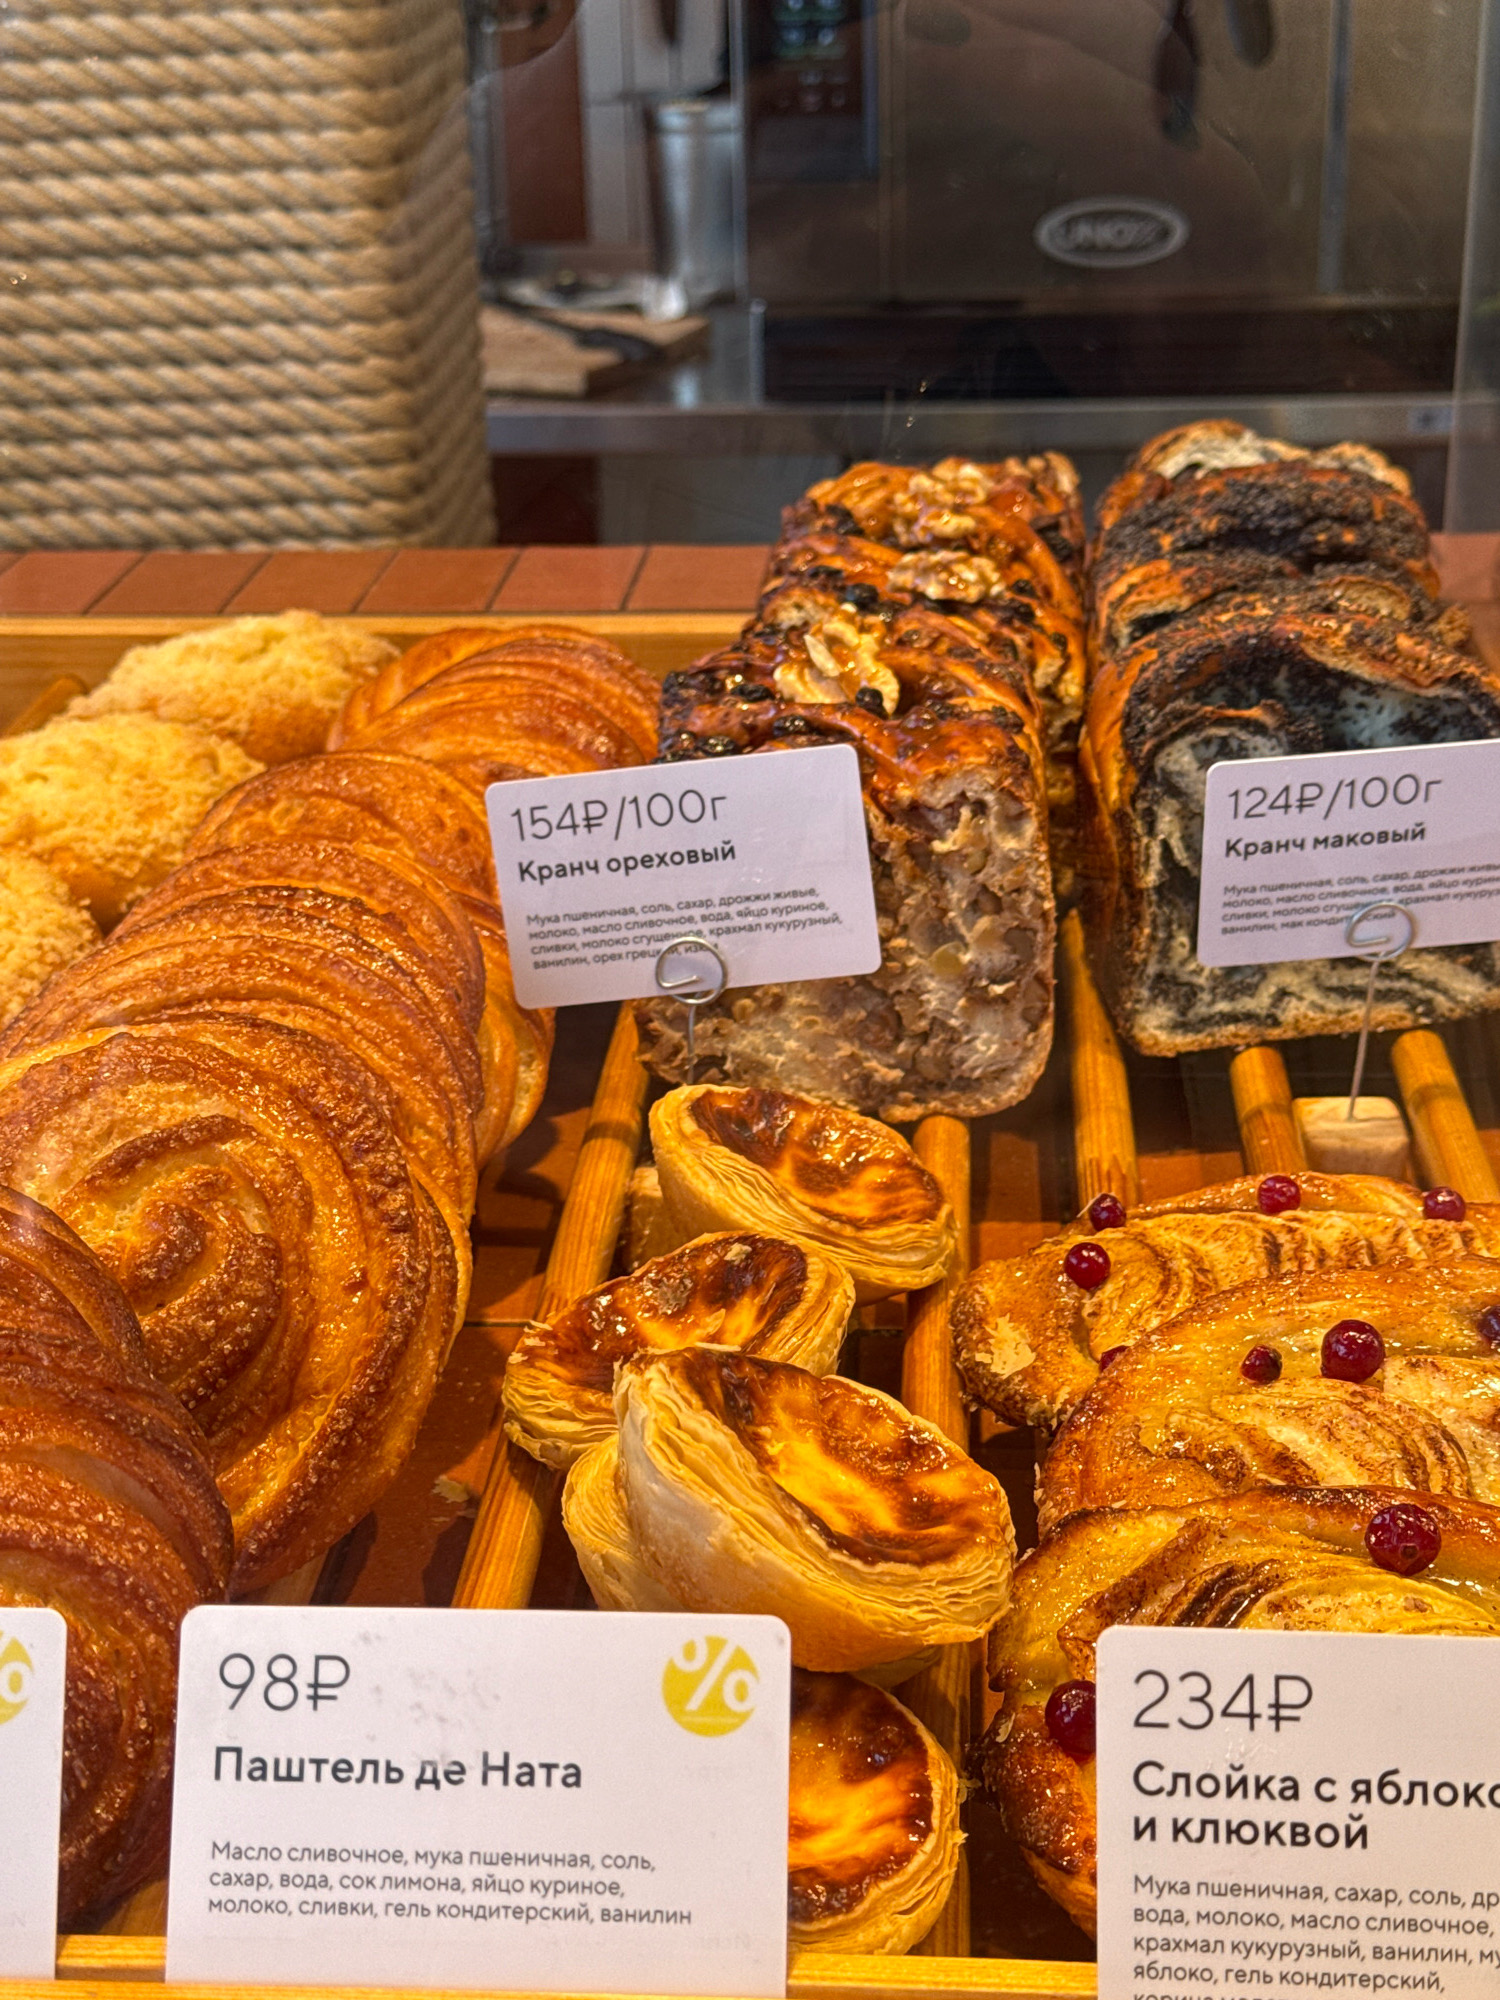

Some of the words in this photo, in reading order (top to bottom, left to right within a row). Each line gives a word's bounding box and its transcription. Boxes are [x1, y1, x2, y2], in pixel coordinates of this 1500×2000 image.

[511, 789, 727, 842] 154₽/100г
[1228, 773, 1442, 820] 124₽/100г
[1225, 837, 1305, 861] Кранч
[1312, 822, 1427, 850] маковый
[518, 860, 599, 885] Кранч
[607, 840, 736, 877] ореховый
[526, 914, 560, 928] Мука
[562, 906, 638, 922] пшеничная,
[641, 903, 674, 914] соль,
[676, 898, 716, 911] сахар,
[718, 893, 771, 907] дрожжи
[772, 887, 820, 900] живые,
[1224, 885, 1257, 897] Мука
[528, 928, 580, 940] молоко,
[582, 923, 622, 934] масло
[624, 915, 698, 930] сливочное,
[701, 911, 733, 923] вода,
[736, 905, 768, 918] яйцо
[771, 901, 830, 916] куриное,
[531, 944, 579, 955] сливки,
[581, 937, 630, 949] молоко
[709, 923, 762, 937] крахмал
[765, 913, 843, 933] кукурузный,
[1281, 919, 1303, 929] мак
[533, 957, 590, 970] ванилин,
[593, 951, 624, 965] орех
[218, 1652, 350, 1712] 98₽
[1133, 1669, 1313, 1732] 234₽
[213, 1746, 404, 1785] Паштель
[415, 1756, 466, 1790] де
[480, 1752, 583, 1789] Ната
[1133, 1760, 1300, 1801] Слойка
[1314, 1777, 1338, 1802] с
[1133, 1816, 1157, 1842] и
[1173, 1813, 1368, 1850] клюквой
[211, 1841, 282, 1863] Масло
[287, 1847, 408, 1867] сливочное,
[414, 1849, 464, 1871] мука
[469, 1848, 594, 1871] пшеничная,
[601, 1853, 655, 1873] соль,
[209, 1872, 274, 1893] сахар,
[279, 1873, 333, 1893] вода,
[339, 1874, 377, 1890] сок
[380, 1875, 466, 1895] лимона,
[471, 1871, 525, 1896] яйцо
[529, 1878, 626, 1901] куриное,
[1134, 1875, 1190, 1900] Мука
[1196, 1881, 1330, 1904] пшеничная,
[1335, 1885, 1402, 1909] сахар,
[1409, 1889, 1466, 1909] соль,
[208, 1898, 293, 1919] молоко,
[297, 1899, 379, 1920] сливки,
[384, 1902, 431, 1919] гель
[436, 1899, 595, 1925] кондитерский,
[600, 1906, 692, 1926] ванилин
[1133, 1907, 1189, 1928] вода,
[1196, 1910, 1284, 1931] молоко,
[1291, 1912, 1360, 1931] масло
[1365, 1914, 1494, 1939] сливочное,
[1133, 1936, 1224, 1957] крахмал
[1231, 1939, 1366, 1962] кукурузный,
[1372, 1943, 1473, 1967] ванилин,
[1133, 1960, 1218, 1985] яблоко,
[1225, 1968, 1273, 1984] гель
[1280, 1970, 1445, 1994] кондитерский,
